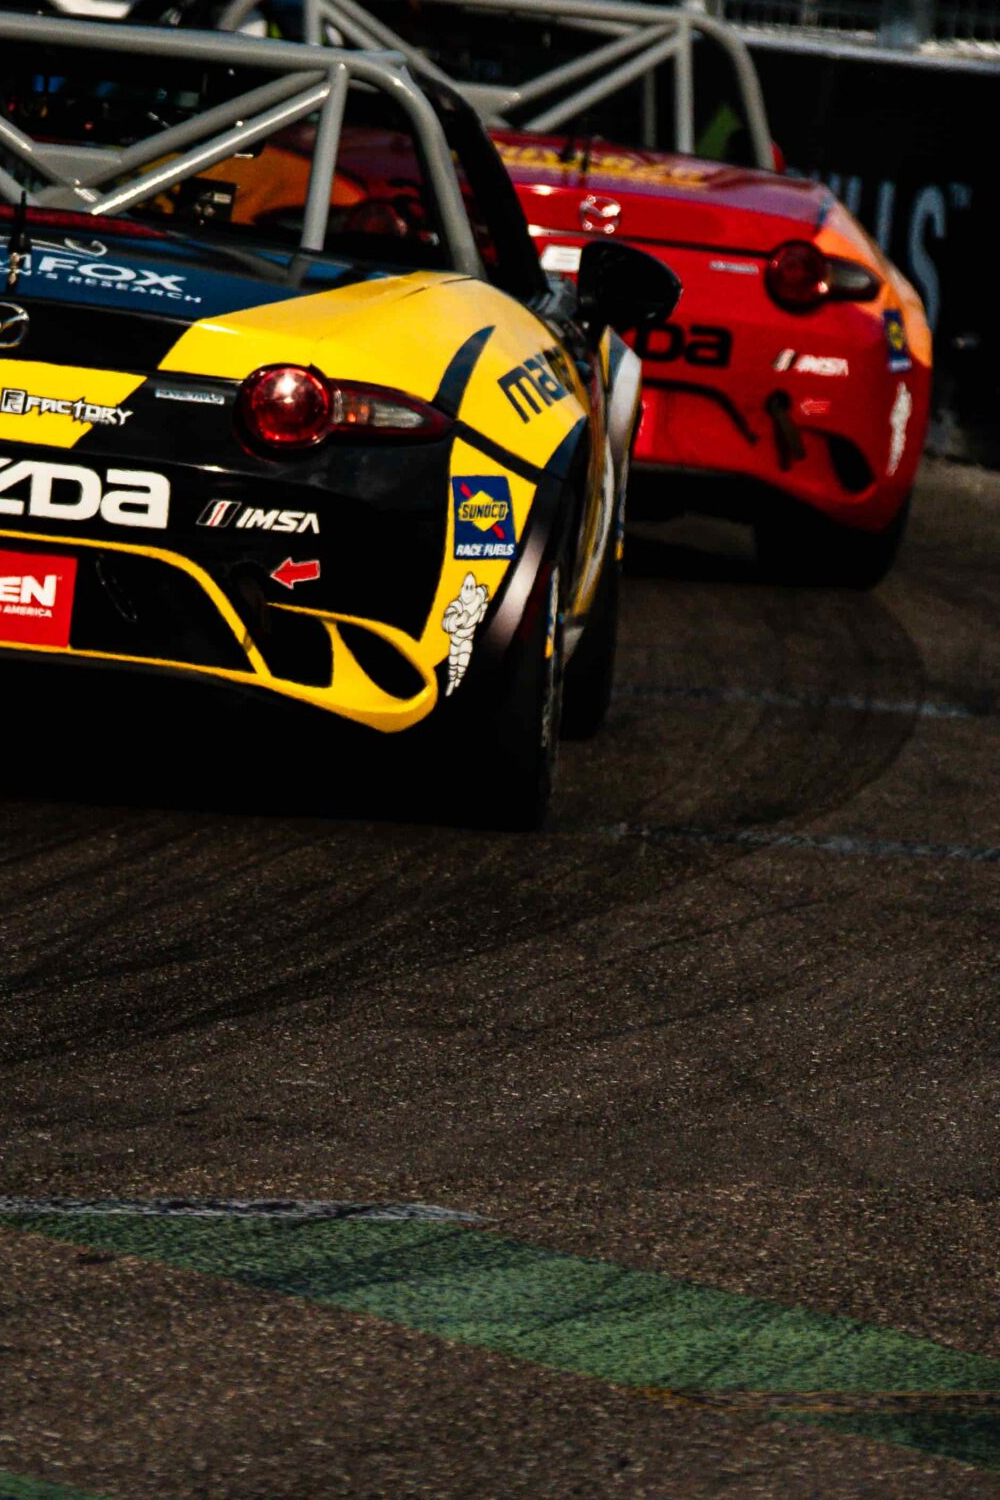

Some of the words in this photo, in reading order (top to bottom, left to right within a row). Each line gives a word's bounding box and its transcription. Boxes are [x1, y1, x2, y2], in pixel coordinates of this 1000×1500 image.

[68, 275, 202, 303] RESEARCH
[461, 503, 507, 519] SUNOCO
[235, 507, 320, 534] IMSA
[456, 543, 483, 556] RACE
[483, 543, 515, 556] FUELS
[3, 603, 53, 619] AMERICA
